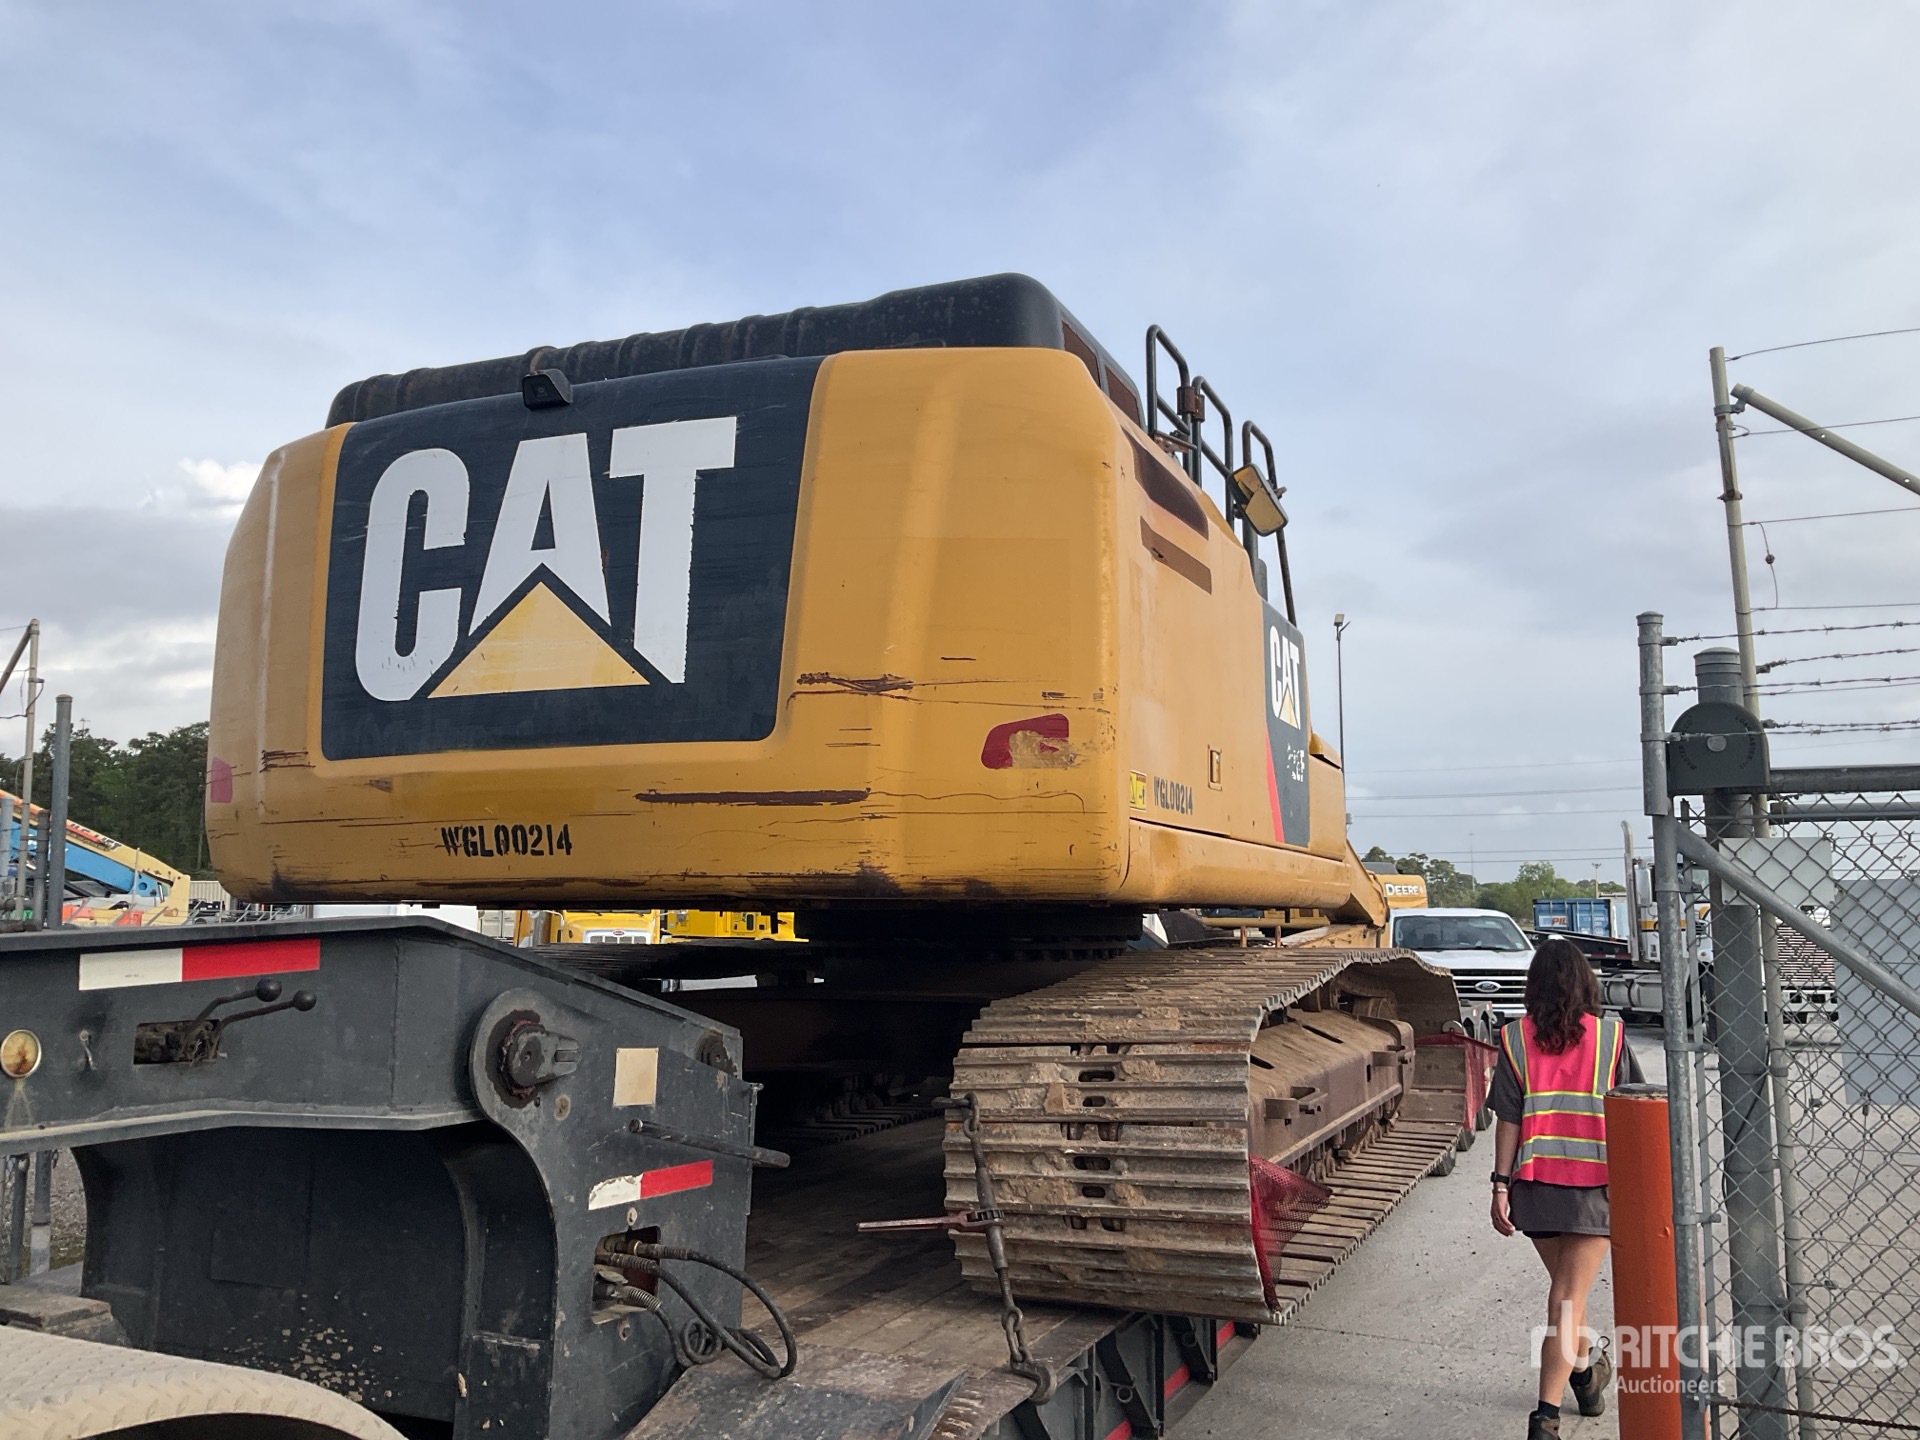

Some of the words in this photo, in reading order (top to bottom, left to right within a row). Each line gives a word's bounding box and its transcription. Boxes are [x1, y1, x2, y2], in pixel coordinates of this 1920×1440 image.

[355, 416, 737, 701] CAT
[1269, 625, 1301, 730] CAT
[1153, 776, 1193, 815] WGL00214
[440, 823, 572, 857] WGL00214
[1385, 883, 1419, 896] DEERE
